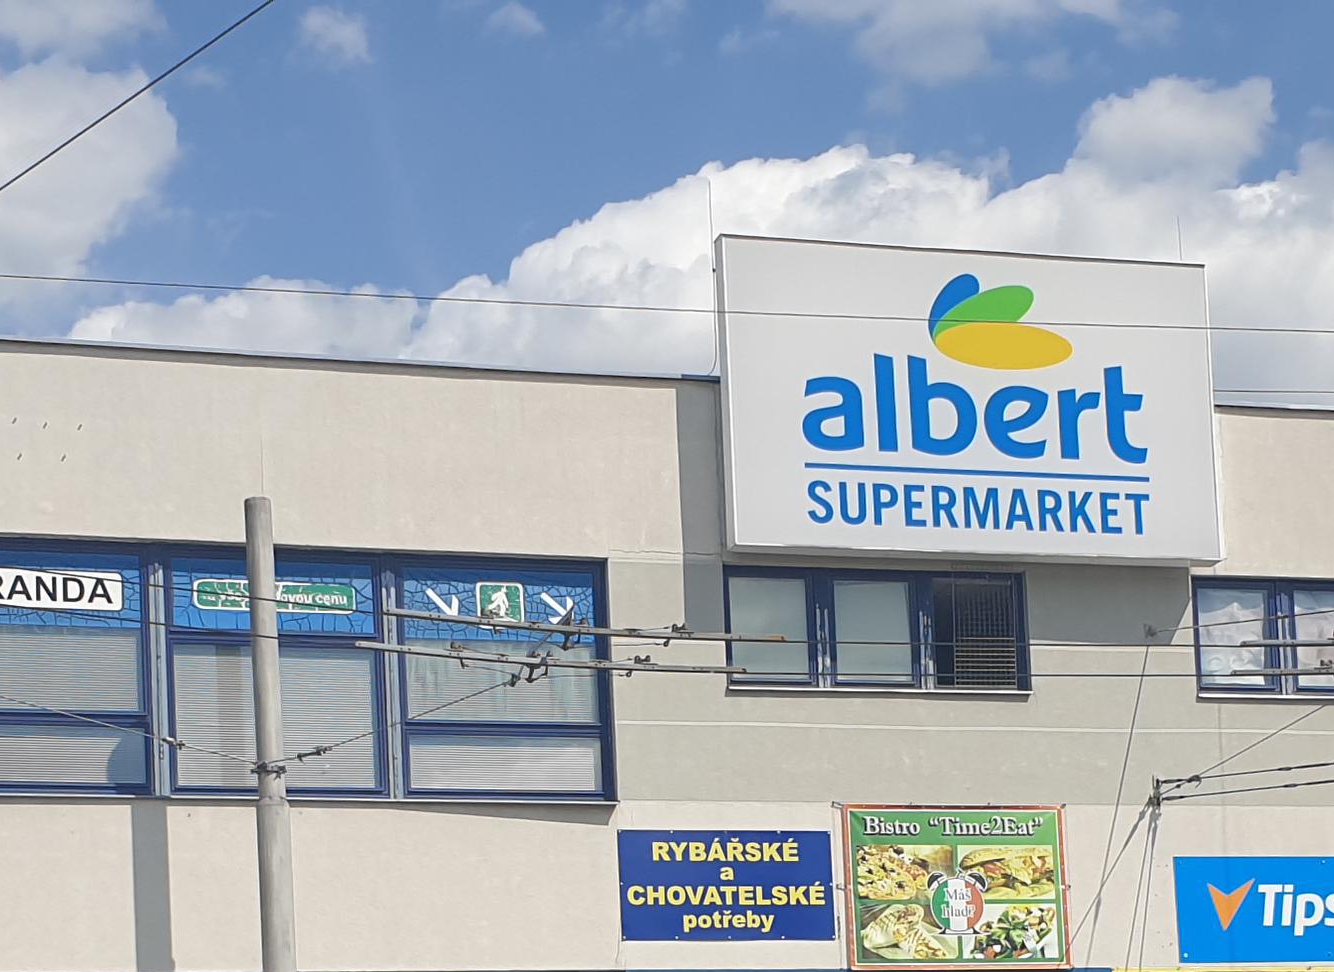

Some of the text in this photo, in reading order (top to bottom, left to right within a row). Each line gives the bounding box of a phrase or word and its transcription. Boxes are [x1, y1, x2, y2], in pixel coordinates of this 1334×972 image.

[802, 353, 1149, 464] albert
[807, 480, 1149, 536] SUPERMARKET
[863, 816, 920, 836] Bistro
[652, 838, 799, 862] RYBÁŘSKÉ
[720, 867, 734, 880] a
[627, 881, 825, 906] CHOVATELSKÉ
[683, 910, 775, 932] potřeby
